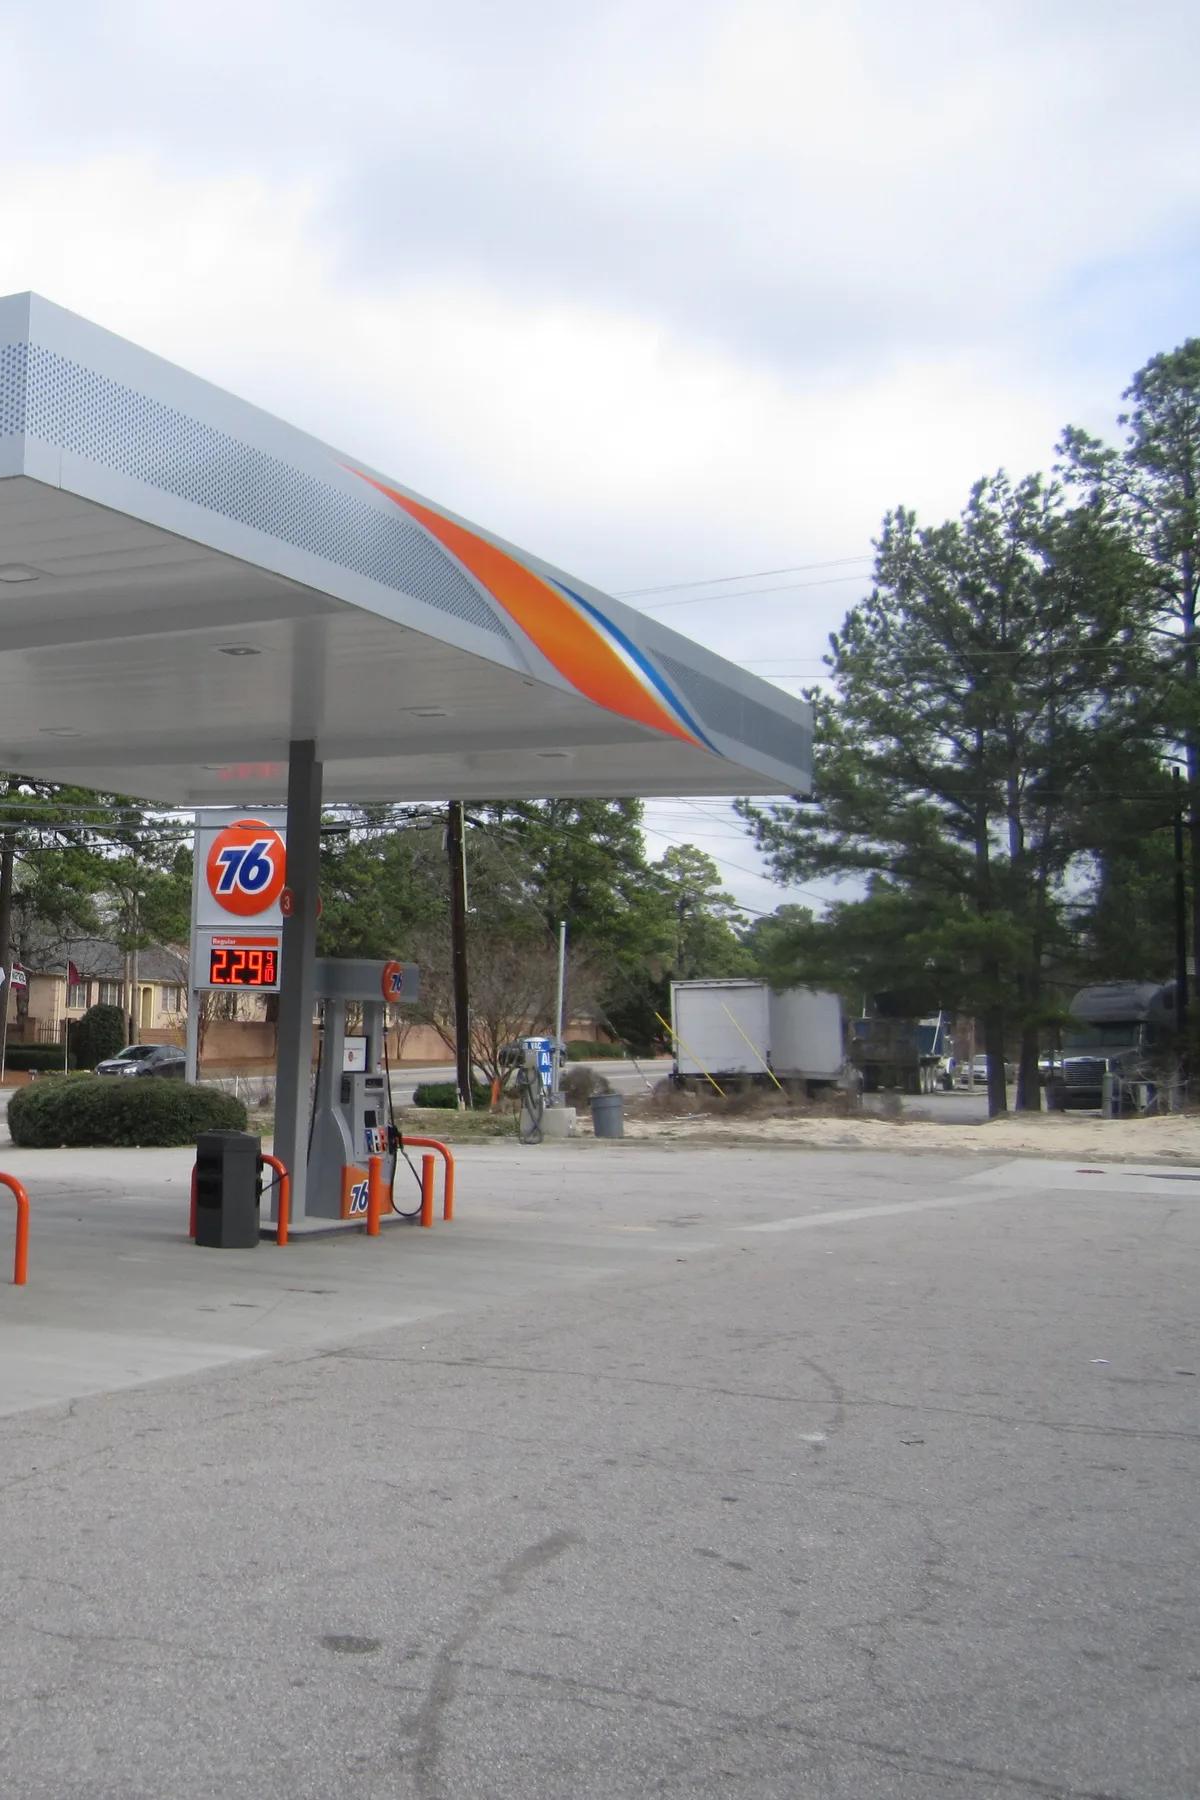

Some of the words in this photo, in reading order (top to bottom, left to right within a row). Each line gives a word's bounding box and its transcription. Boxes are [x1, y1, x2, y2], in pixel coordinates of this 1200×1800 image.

[215, 839, 276, 895] 76
[283, 896, 291, 910] 3
[212, 937, 236, 946] Regular
[211, 950, 263, 985] 2.29
[389, 971, 403, 994] 76
[349, 1179, 368, 1214] 76
